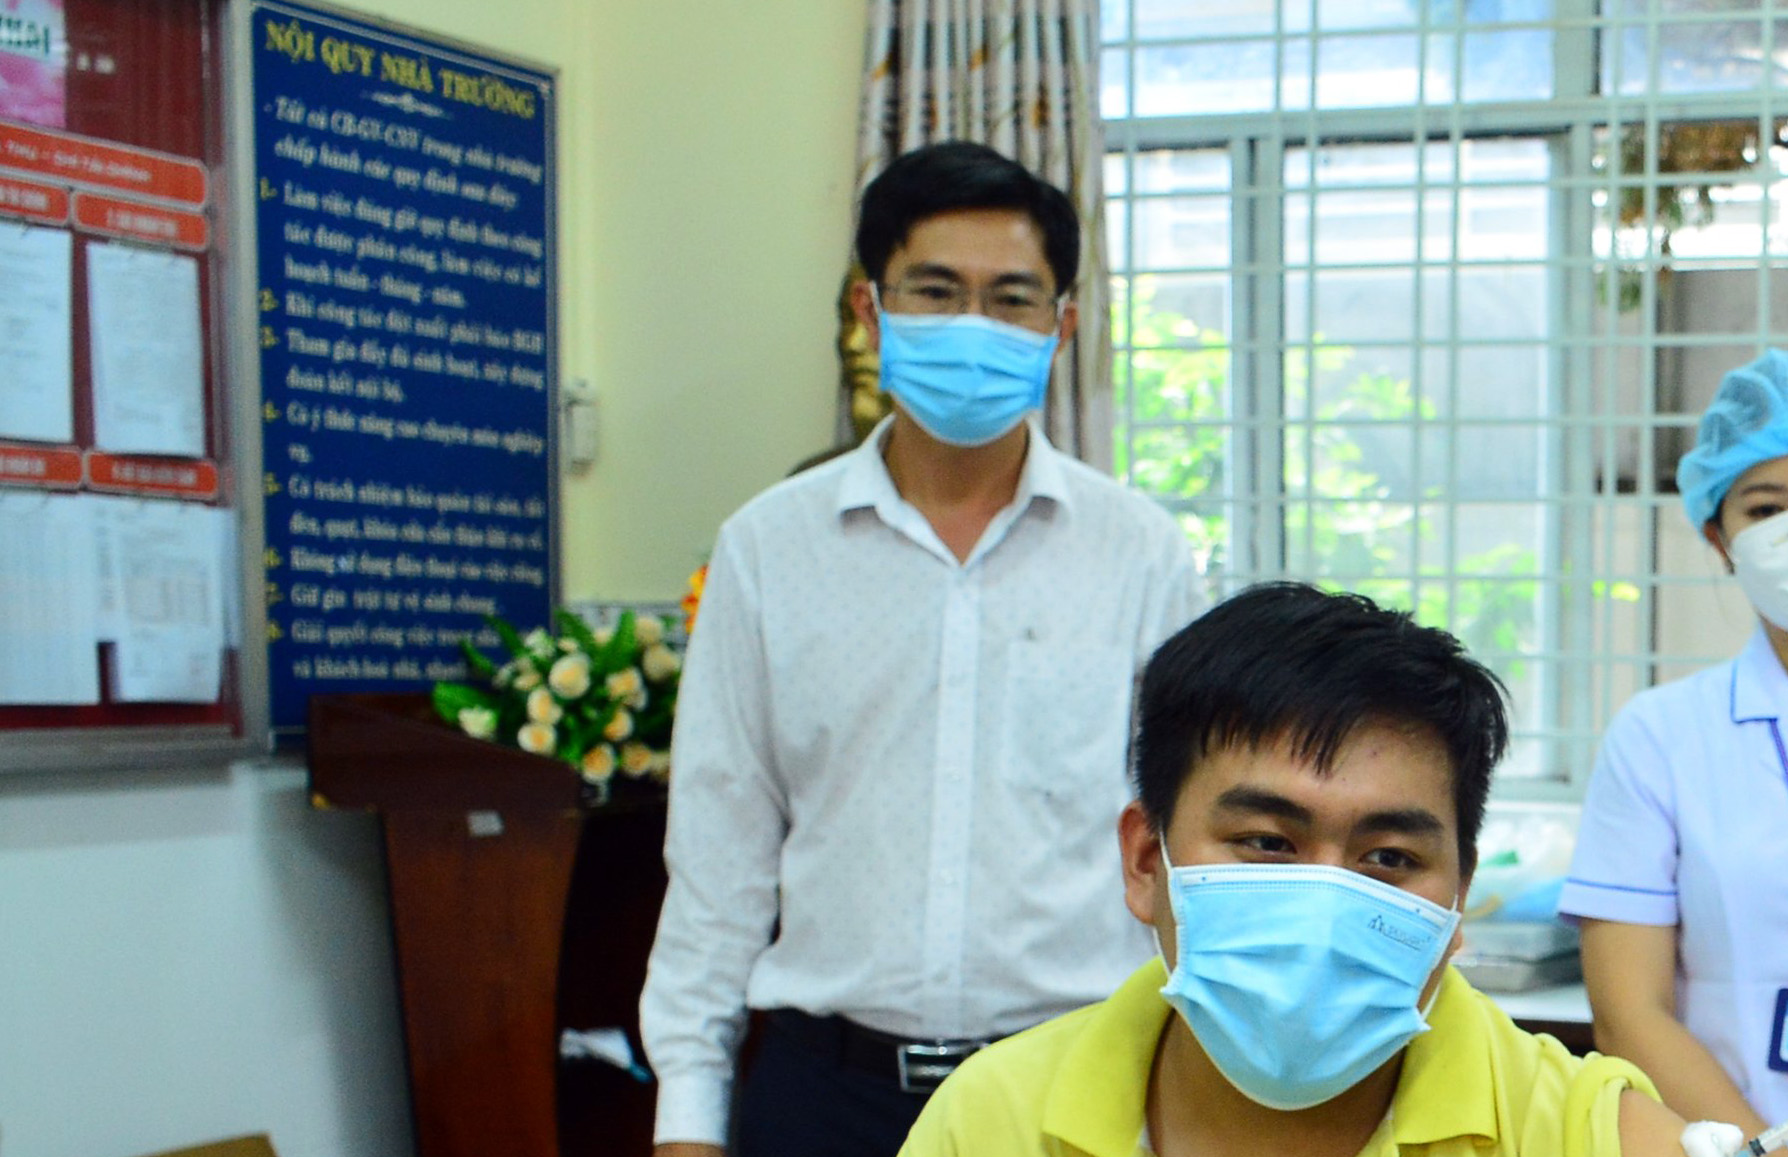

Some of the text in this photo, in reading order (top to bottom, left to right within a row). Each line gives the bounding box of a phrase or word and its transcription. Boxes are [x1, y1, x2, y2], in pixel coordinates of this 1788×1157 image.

[266, 18, 535, 119] NỘI QUY NHÀ TRƯỜNG
